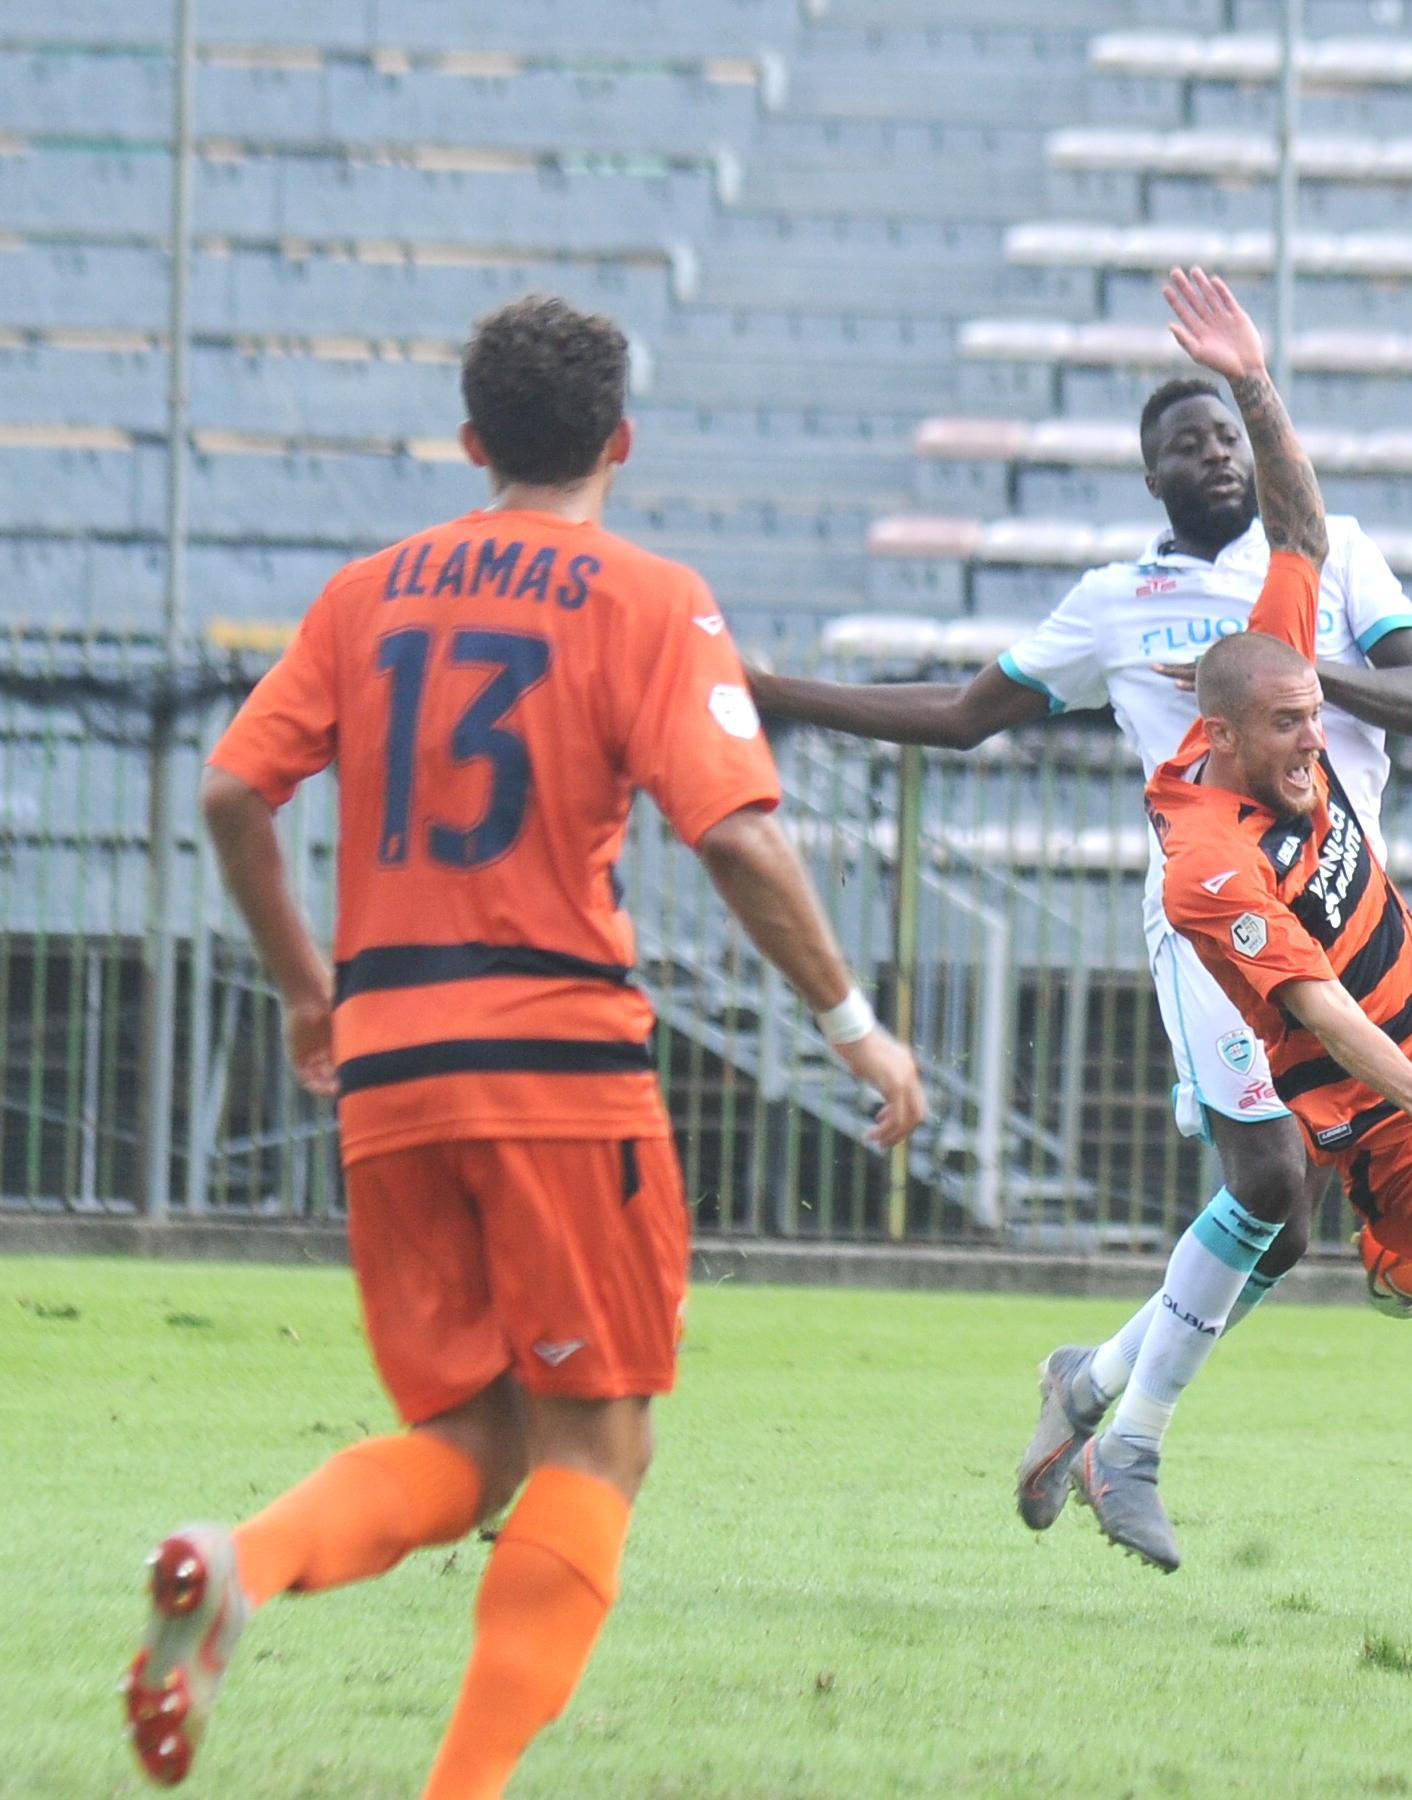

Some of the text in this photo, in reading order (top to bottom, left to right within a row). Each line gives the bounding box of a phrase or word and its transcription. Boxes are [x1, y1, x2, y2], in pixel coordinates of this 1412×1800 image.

[384, 537, 600, 611] LLAMAS
[375, 624, 552, 872] 13
[1162, 1293, 1216, 1337] OLBIA
